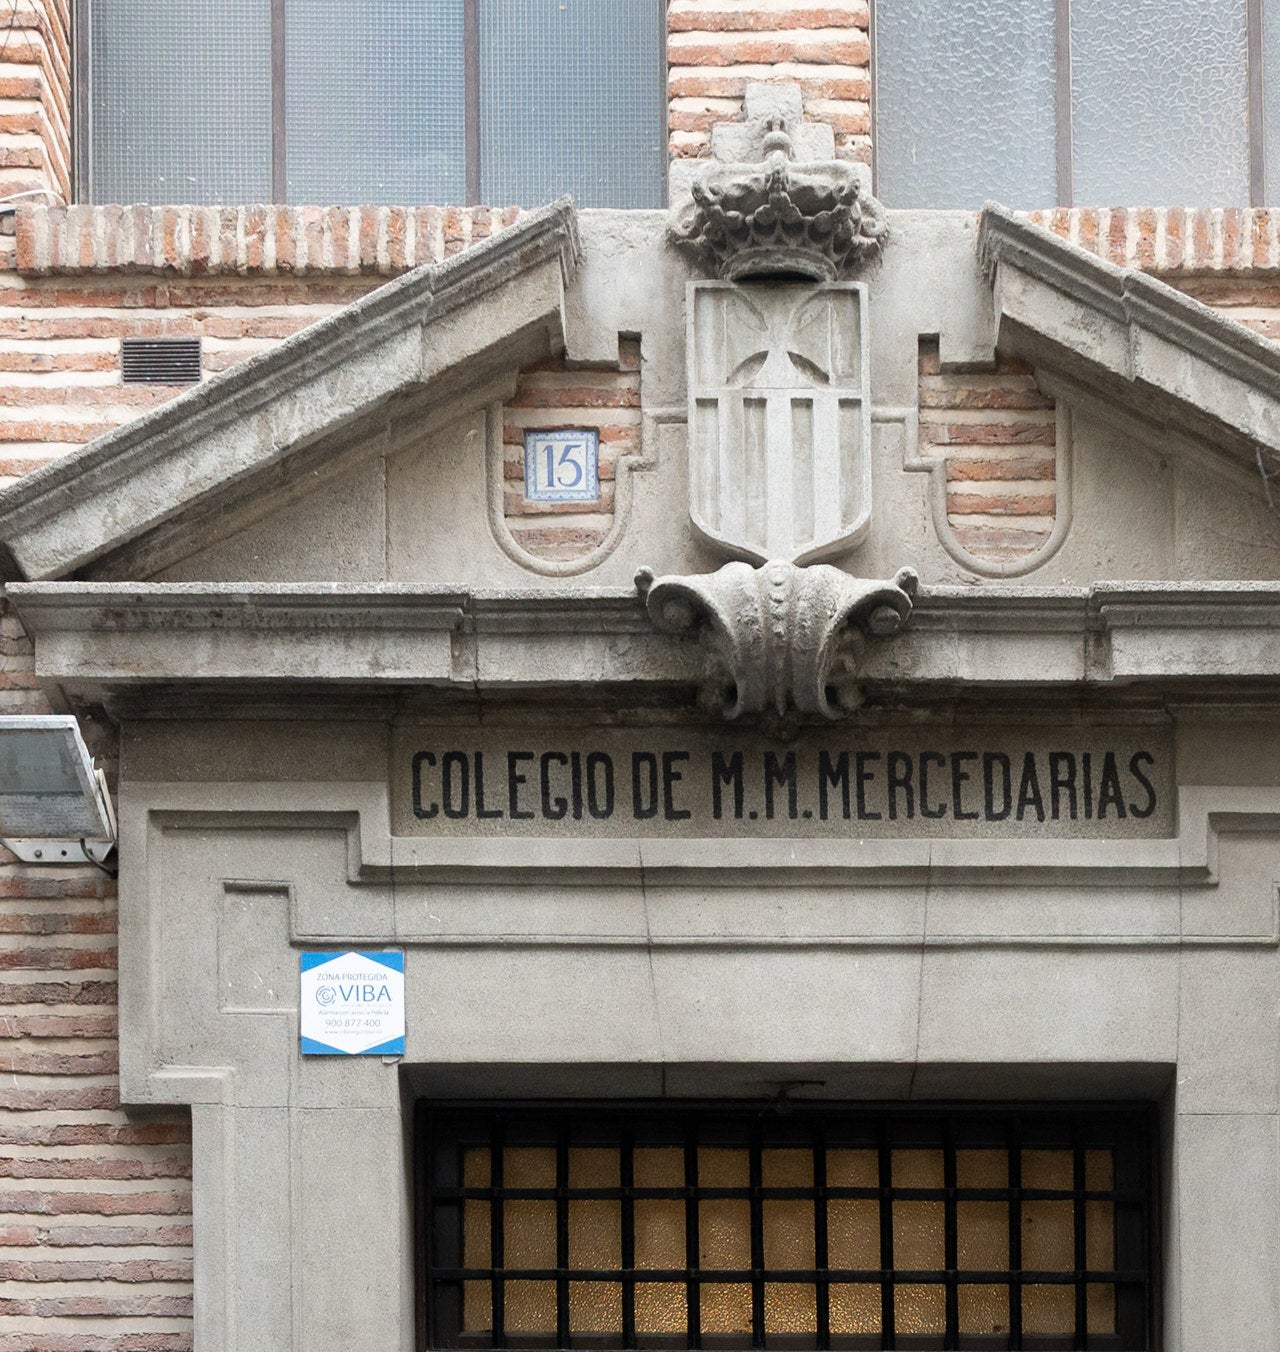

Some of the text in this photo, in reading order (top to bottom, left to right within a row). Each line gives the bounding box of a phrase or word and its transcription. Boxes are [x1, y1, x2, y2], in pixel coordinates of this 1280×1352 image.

[542, 444, 583, 488] 15
[411, 750, 615, 822] COLEGIO
[631, 750, 691, 822] DE
[317, 973, 388, 981] ZONA PROTEGIDA
[339, 985, 392, 1002] VIBA
[325, 1019, 381, 1028] 900 877 400
